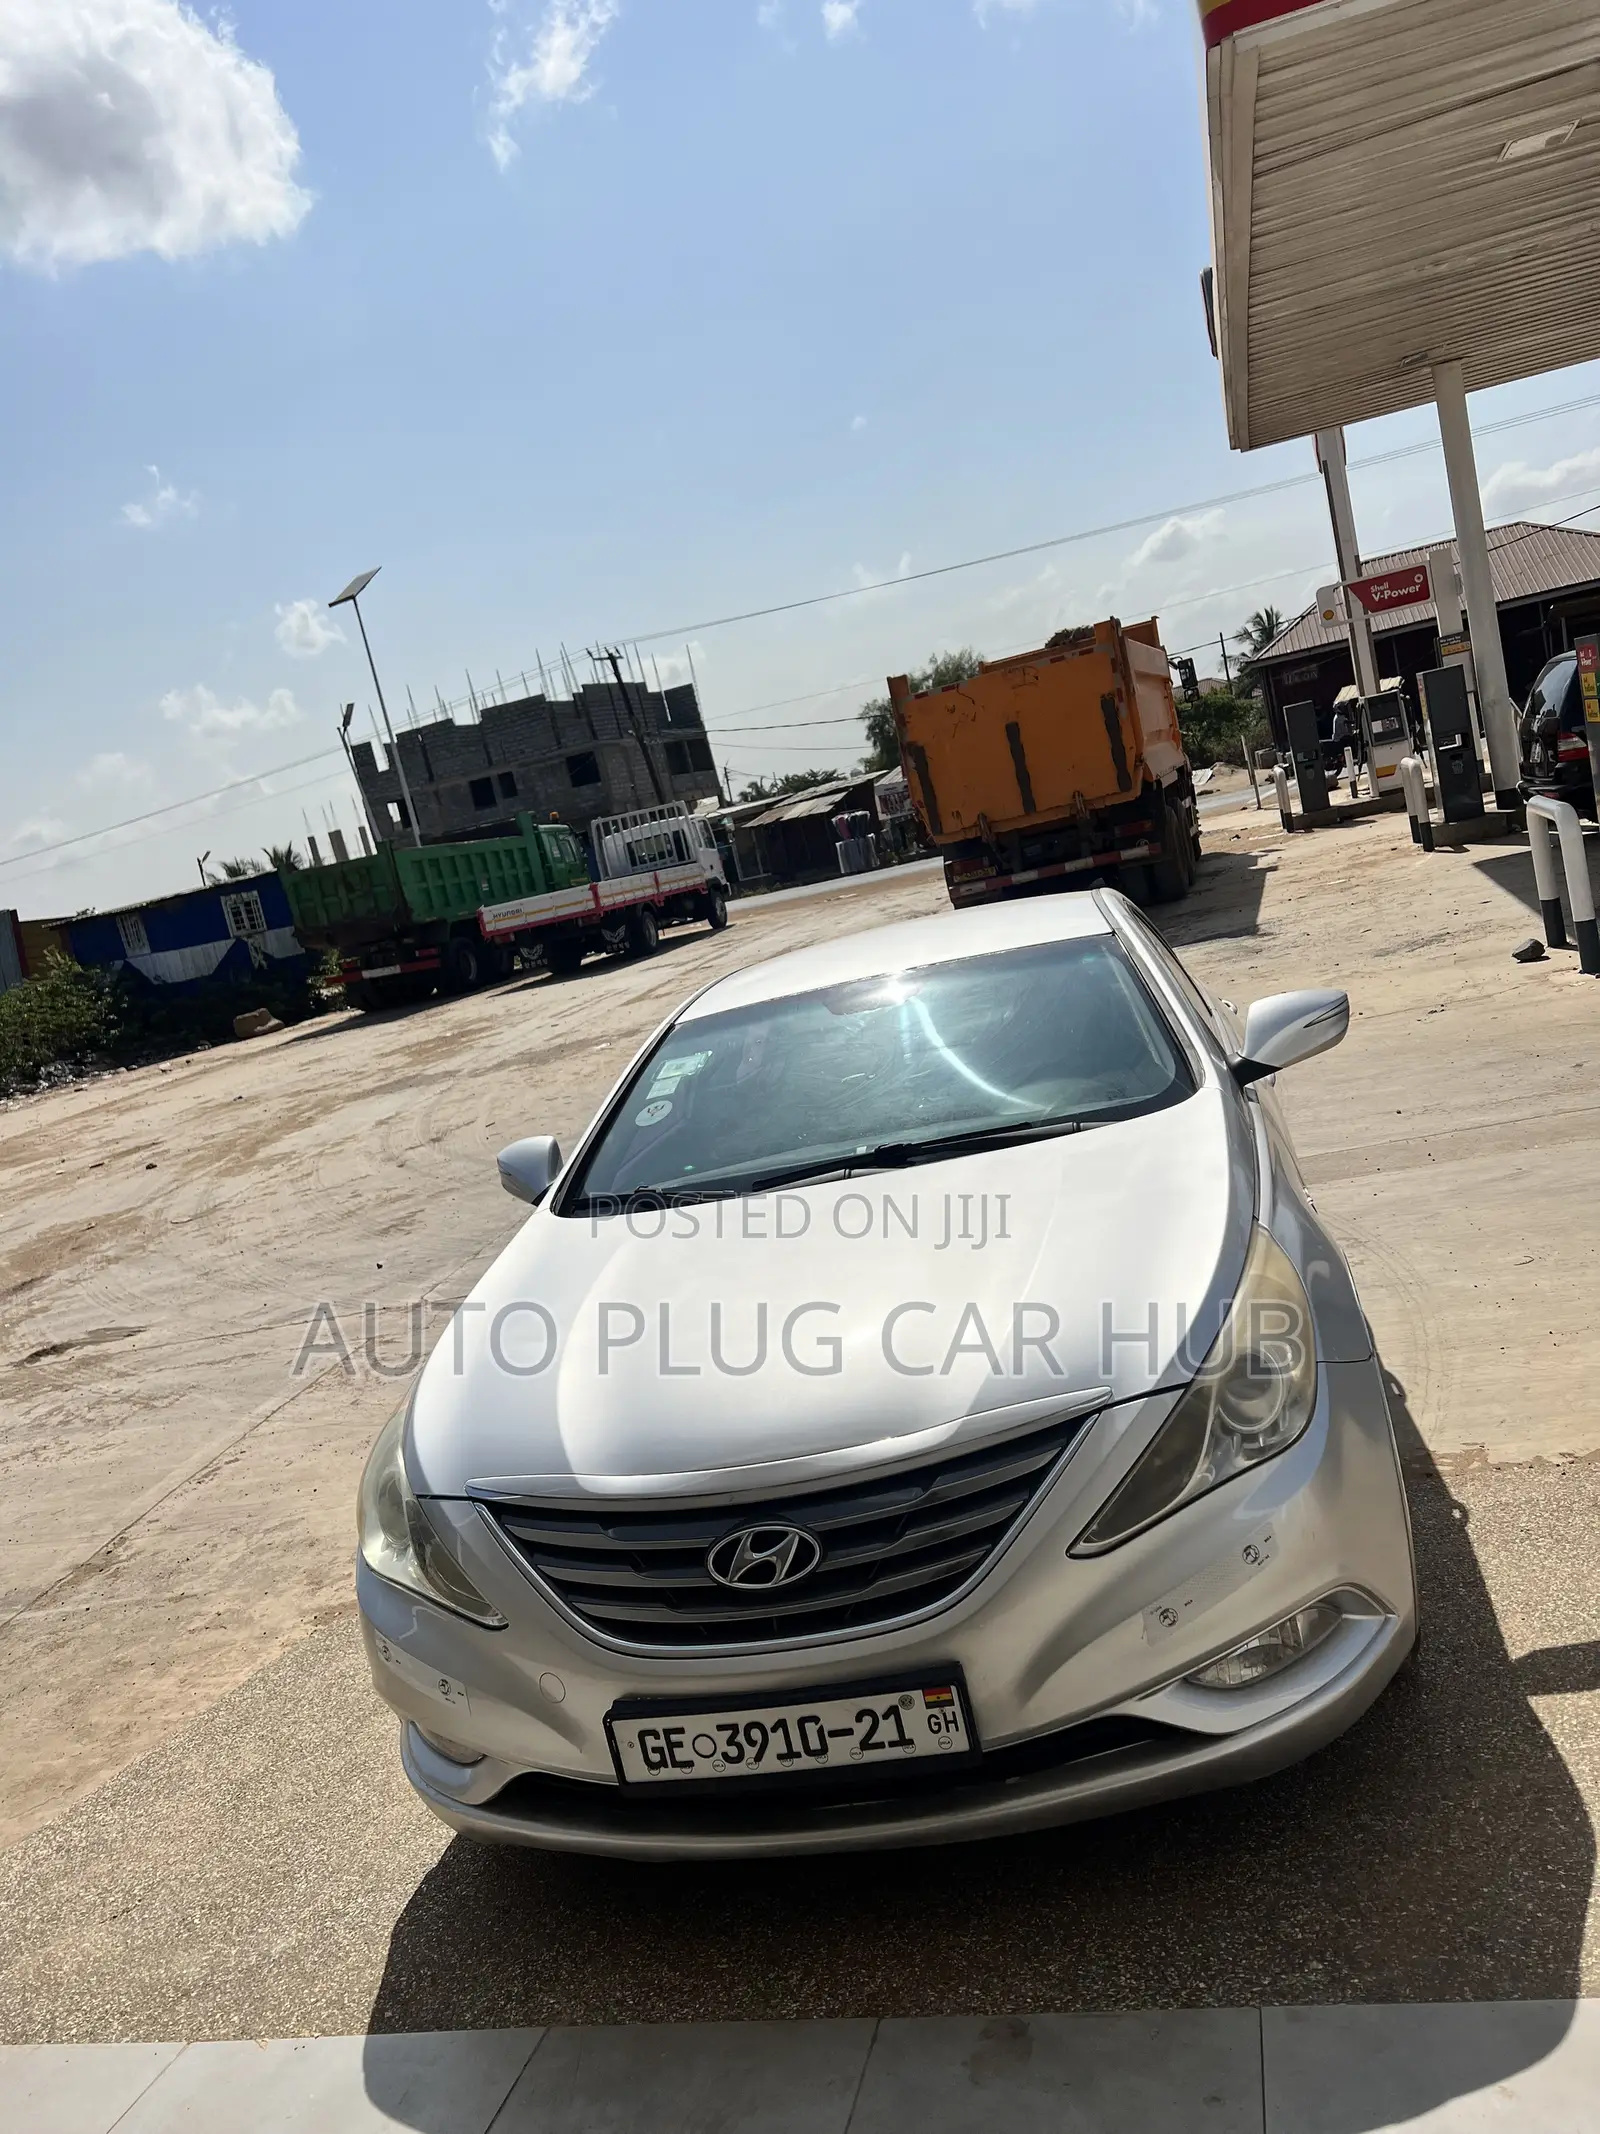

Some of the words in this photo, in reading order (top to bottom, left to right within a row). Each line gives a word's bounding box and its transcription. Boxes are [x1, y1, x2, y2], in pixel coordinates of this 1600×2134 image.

[1370, 582, 1389, 593] Shell
[1372, 584, 1421, 602] V-Power
[927, 1711, 960, 1735] GH
[637, 1727, 694, 1770] GE
[716, 1705, 914, 1763] 3910-21
